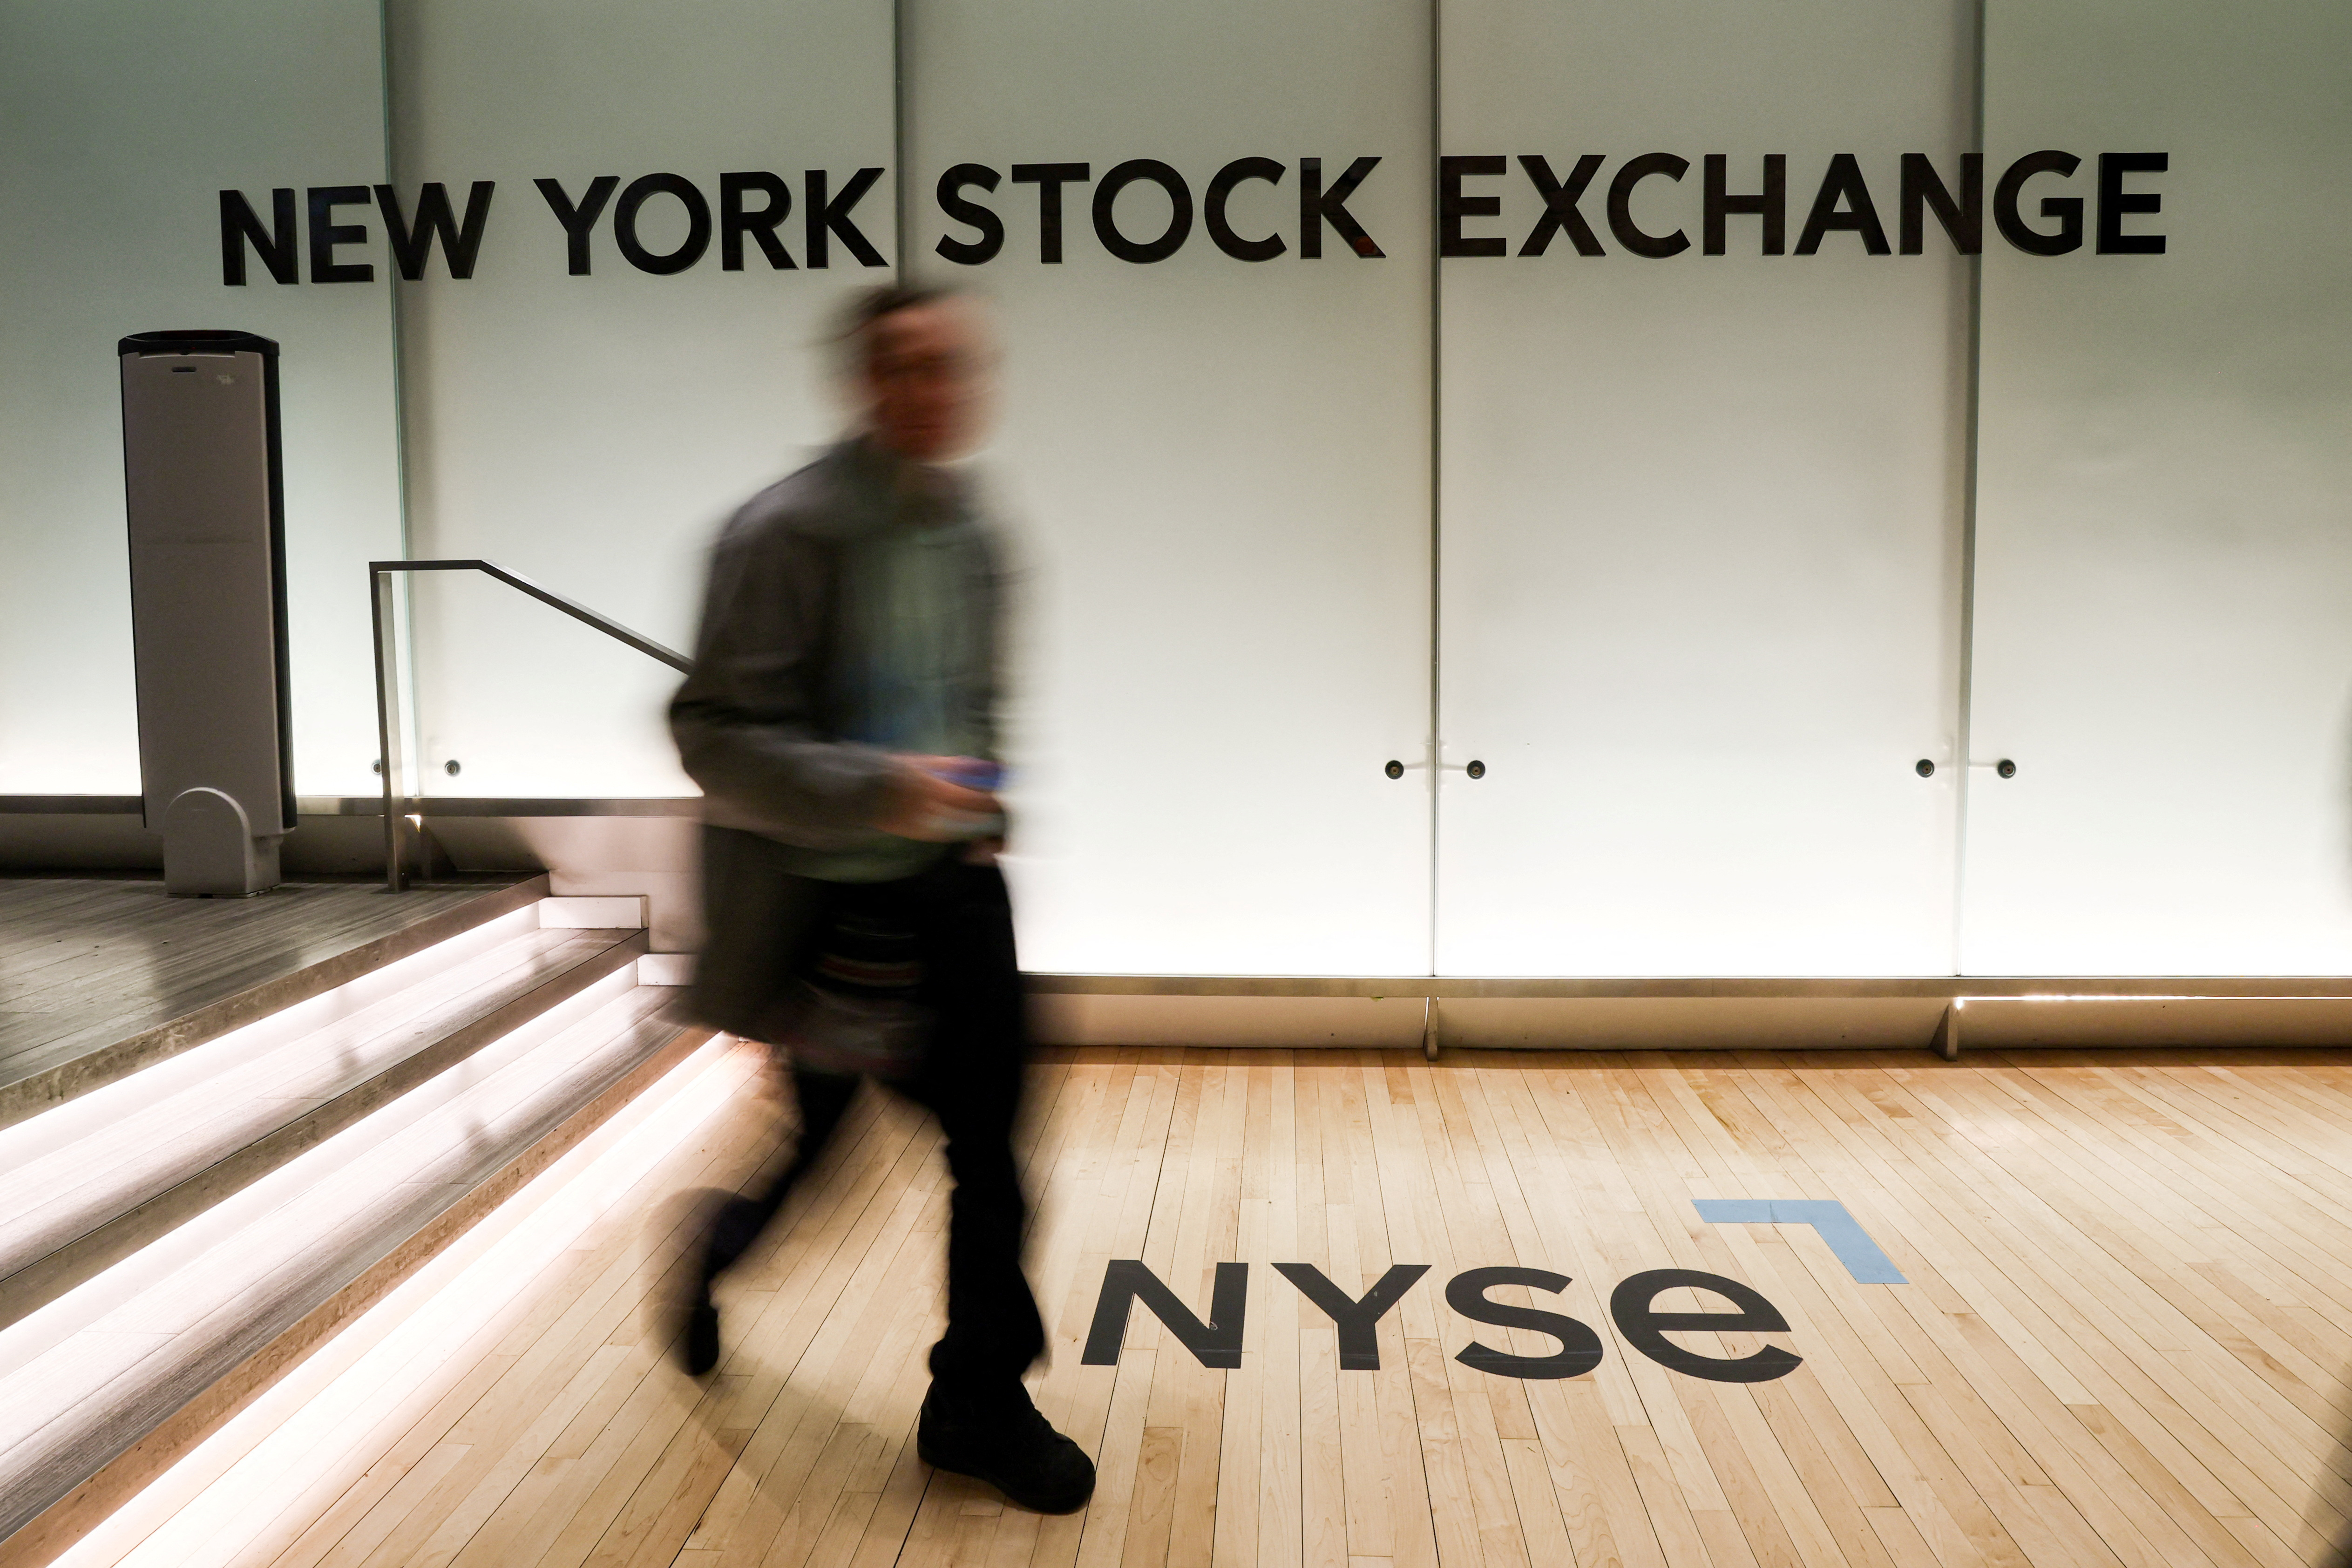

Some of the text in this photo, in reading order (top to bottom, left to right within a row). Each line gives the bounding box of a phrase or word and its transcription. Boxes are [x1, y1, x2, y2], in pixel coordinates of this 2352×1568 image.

[220, 150, 2169, 287] NEW YORK STOCK EXCHANGE
